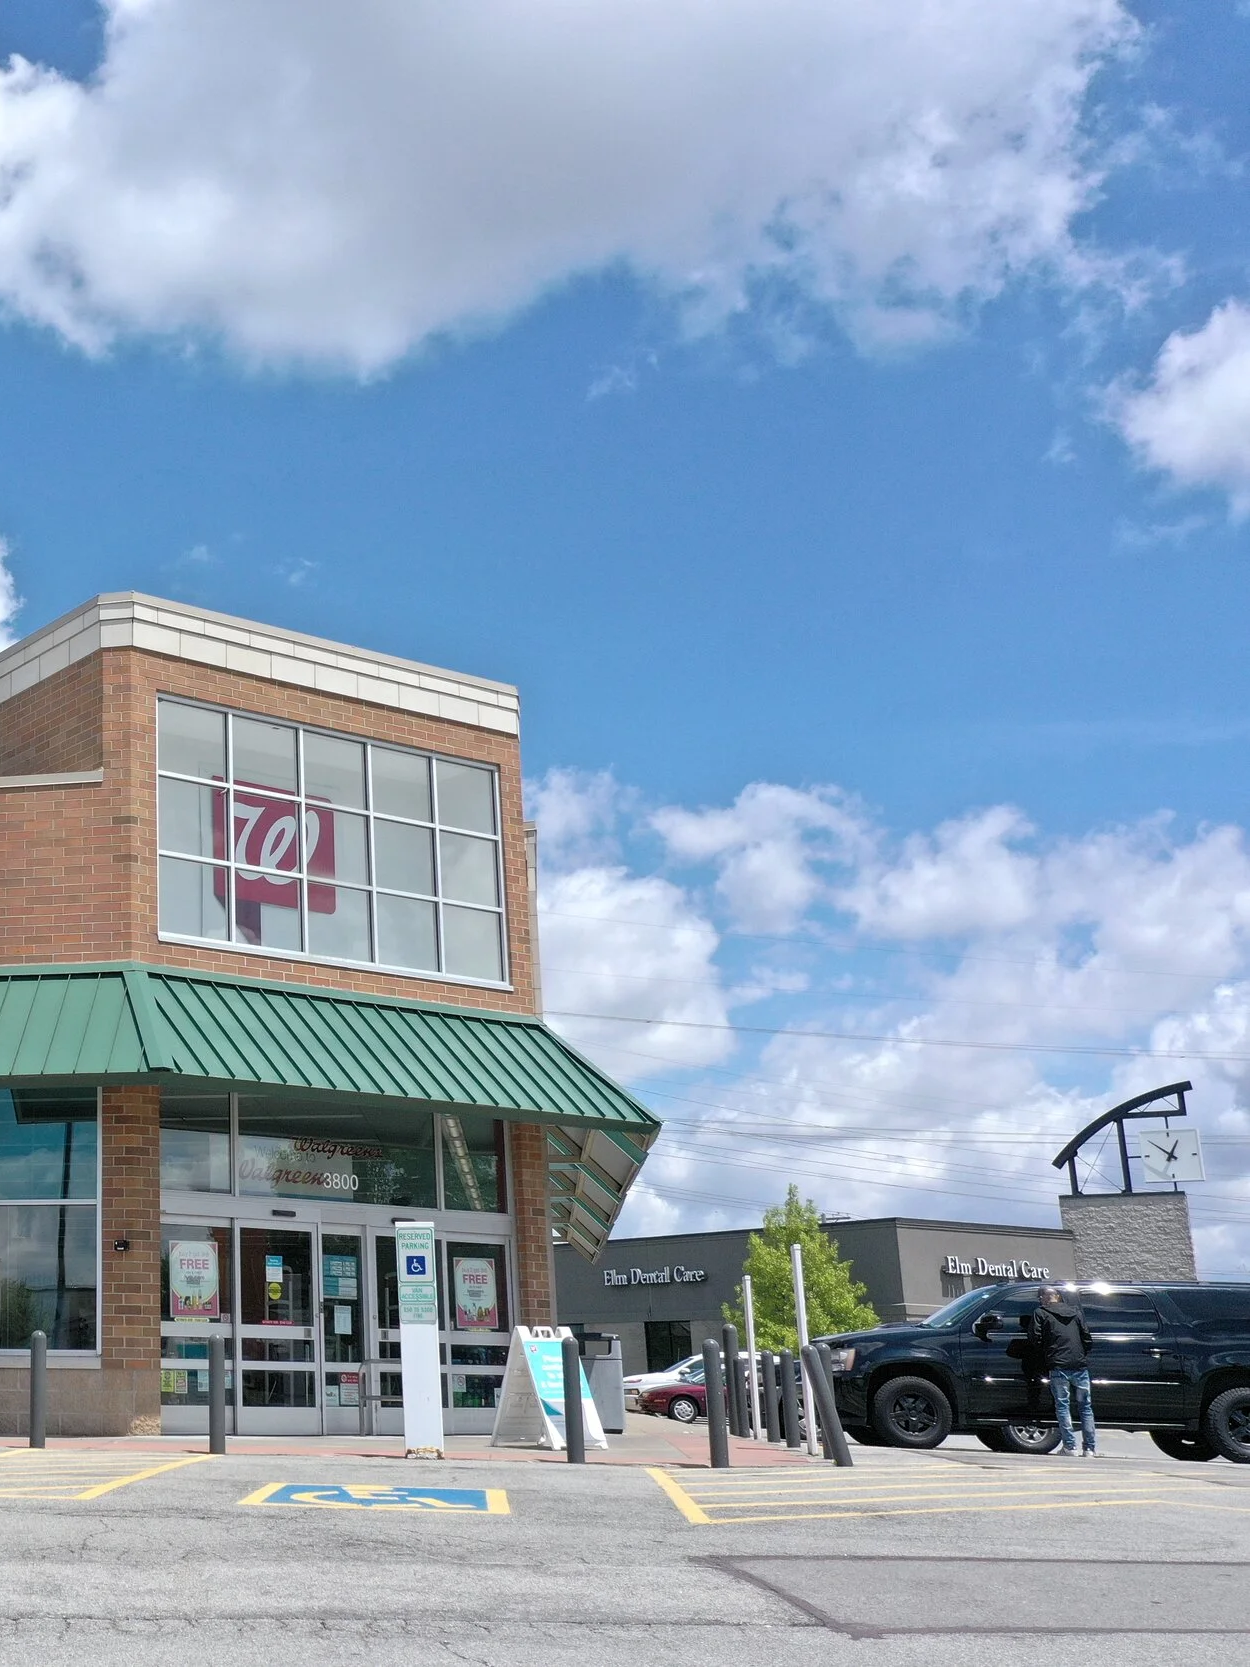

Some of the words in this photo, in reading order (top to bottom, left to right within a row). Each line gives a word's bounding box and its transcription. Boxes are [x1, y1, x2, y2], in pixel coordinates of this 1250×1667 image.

[254, 1144, 304, 1163] Welcome
[306, 1152, 317, 1164] to
[291, 1137, 384, 1160] Walgreens
[323, 1172, 359, 1191] 3800
[180, 1258, 210, 1270] FREE
[946, 1255, 972, 1275] Elm
[976, 1257, 1018, 1277] Dental
[1021, 1260, 1050, 1279] Care
[462, 1274, 488, 1284] FREE
[603, 1269, 628, 1286] Elm
[629, 1266, 671, 1285] Dental
[673, 1265, 705, 1282] Care
